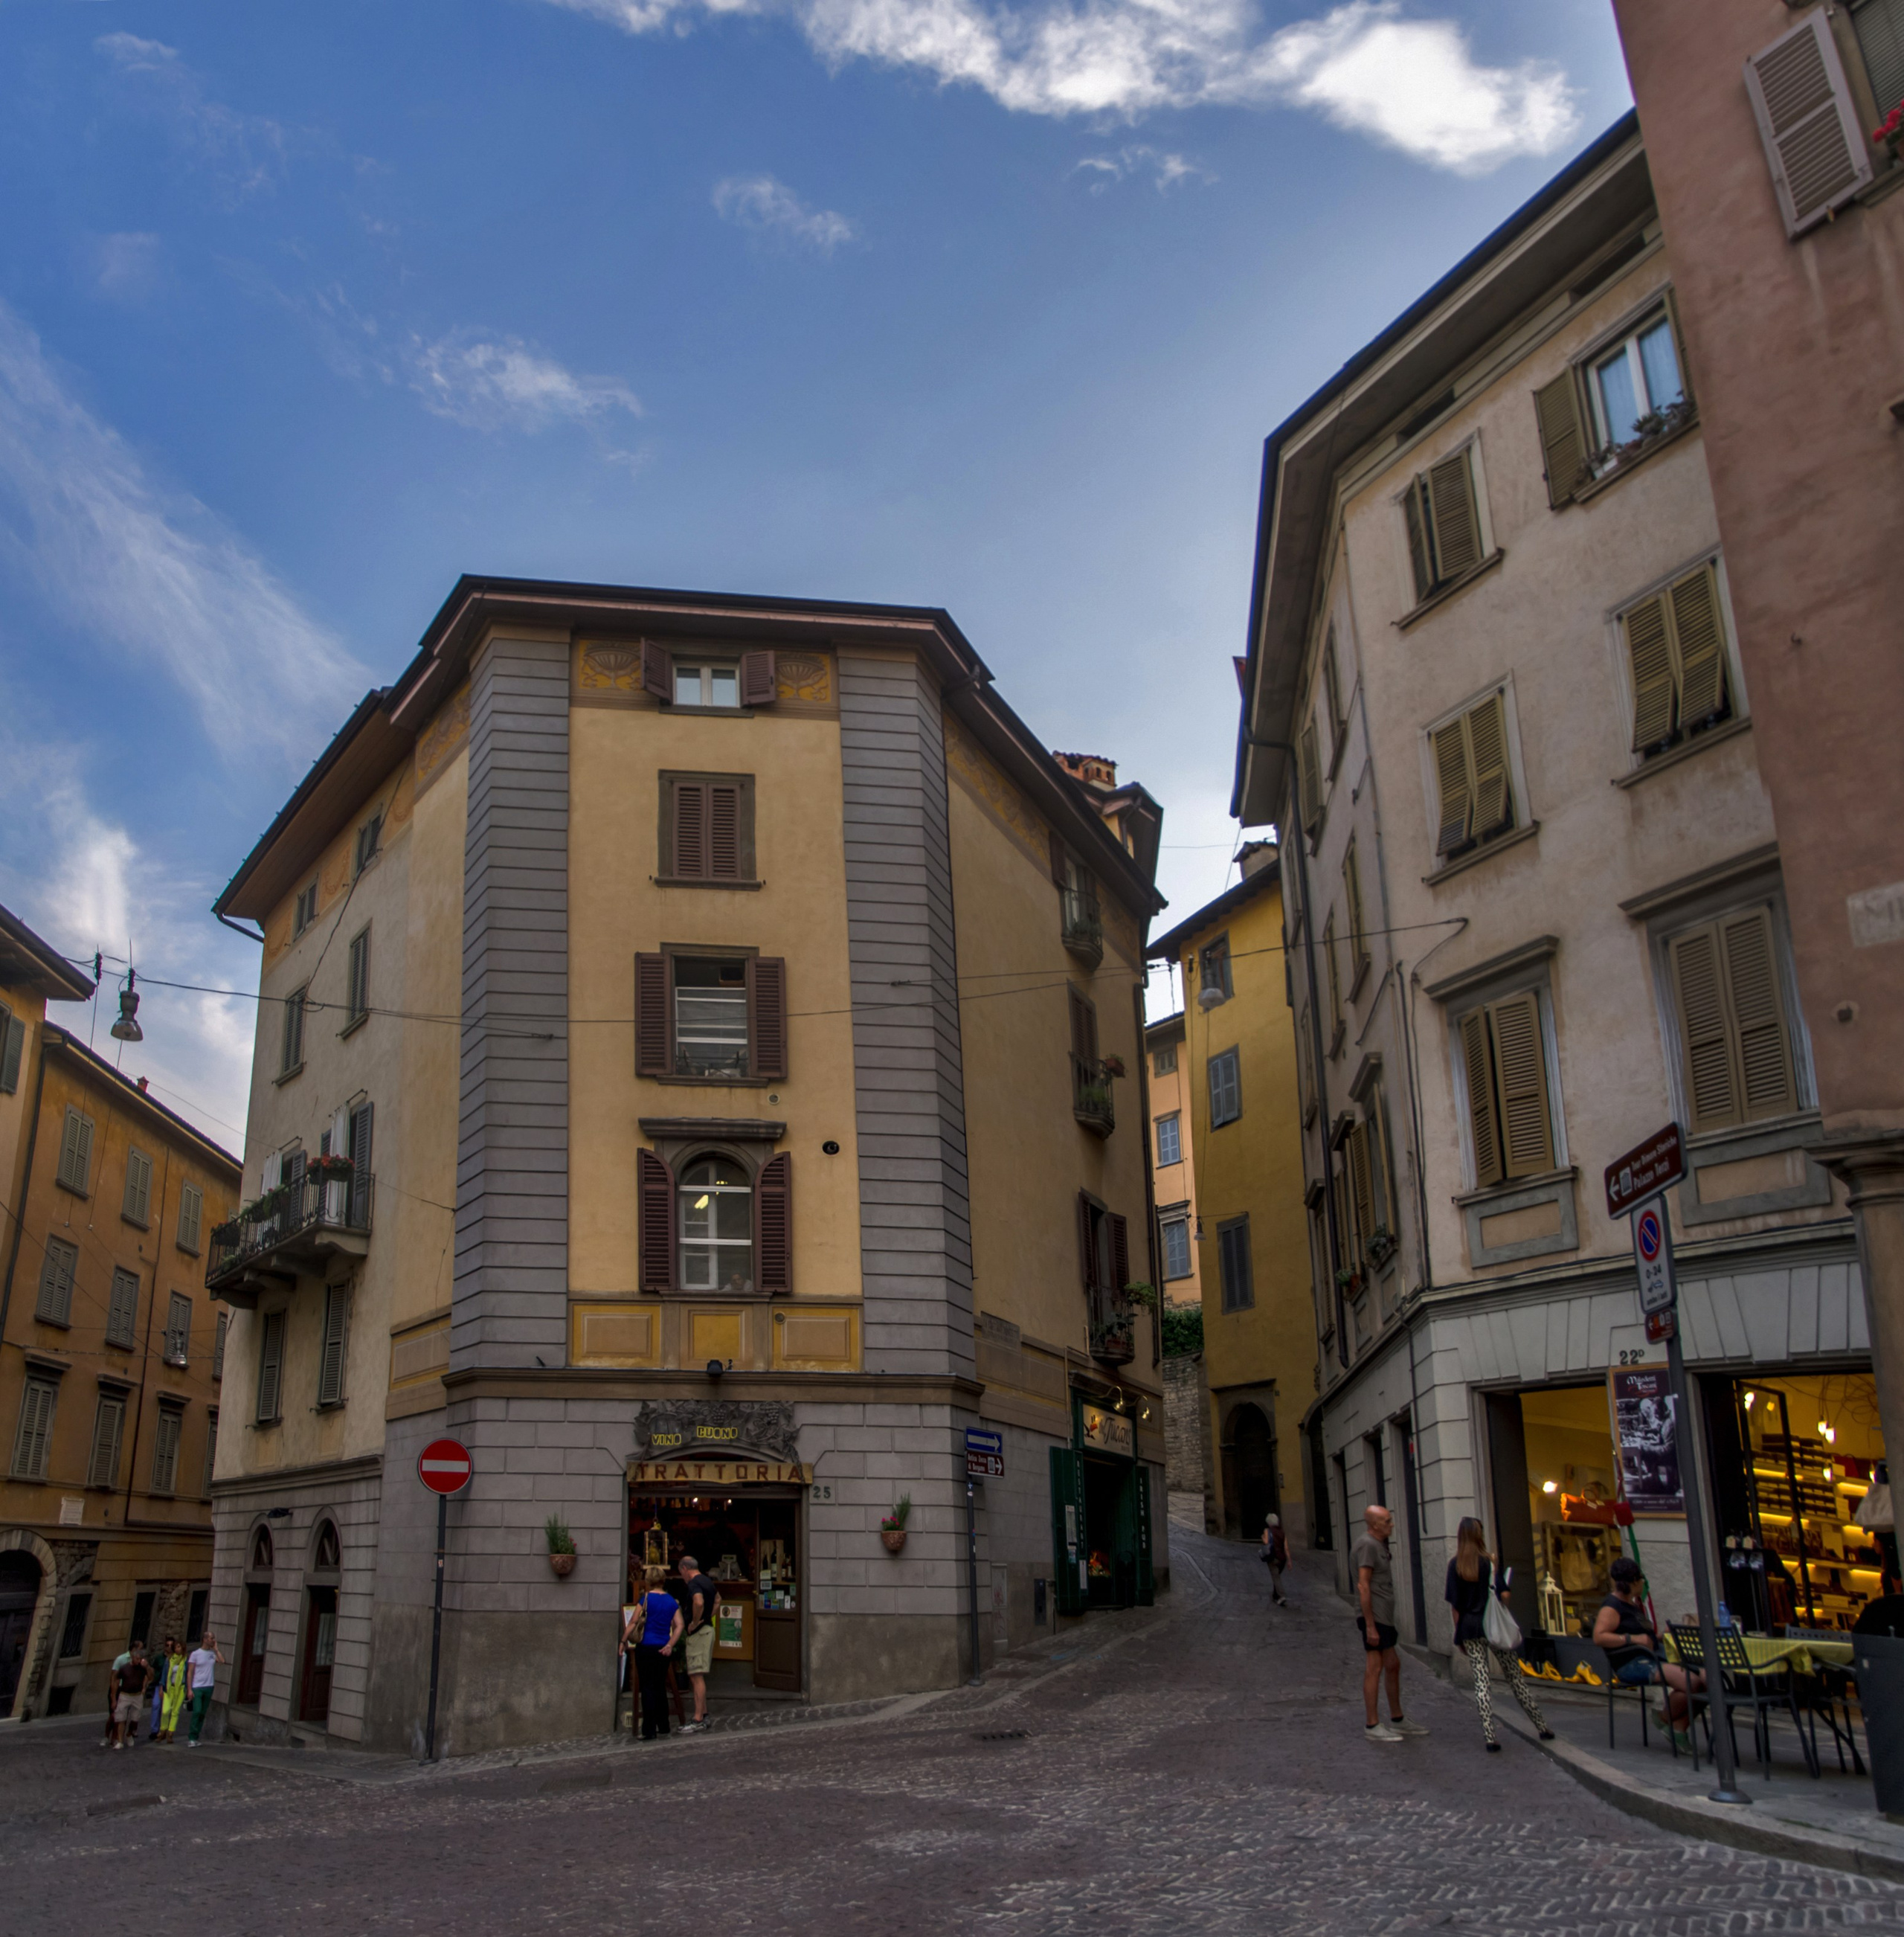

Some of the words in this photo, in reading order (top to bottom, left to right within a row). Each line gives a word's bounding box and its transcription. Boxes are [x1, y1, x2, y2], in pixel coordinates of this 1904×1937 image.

[652, 1433, 682, 1445] VINO
[697, 1426, 738, 1439] BUONO
[639, 1463, 803, 1481] TRATTORIA
[813, 1485, 831, 1499] 25
